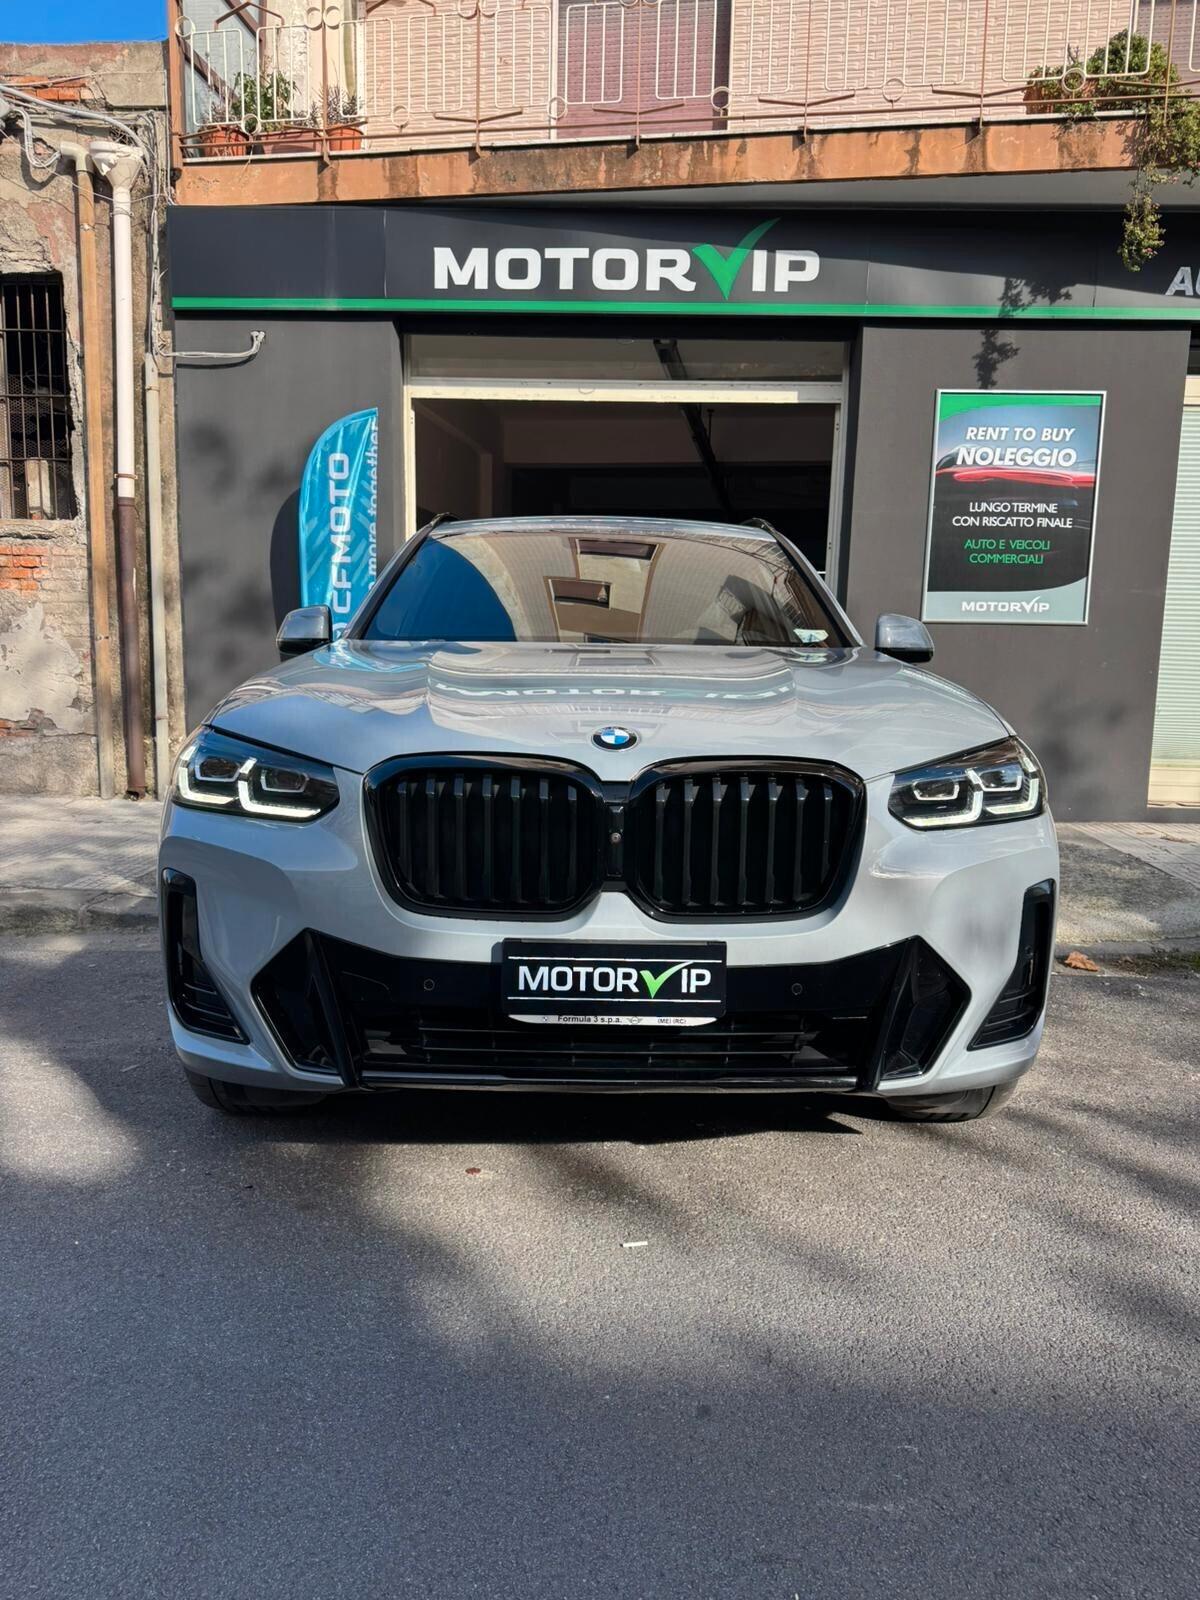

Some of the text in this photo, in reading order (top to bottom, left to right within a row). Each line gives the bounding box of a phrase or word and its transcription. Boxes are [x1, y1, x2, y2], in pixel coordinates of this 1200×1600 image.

[433, 217, 820, 300] MOTORVIP
[965, 426, 1076, 442] RENT TO BUY
[956, 446, 1077, 467] NOLEGGIO
[969, 502, 1058, 514] LUNGO TERMINE
[952, 516, 1073, 529] CON RISCATTO FINALE
[328, 452, 352, 613] CFMOTO
[964, 539, 1051, 550] AUTO E VEICOLI
[969, 553, 1044, 565] COMMERCIALI
[518, 961, 712, 999] MOTORVIP
[557, 1015, 592, 1023] Formula
[600, 1017, 623, 1025] s.p.a.
